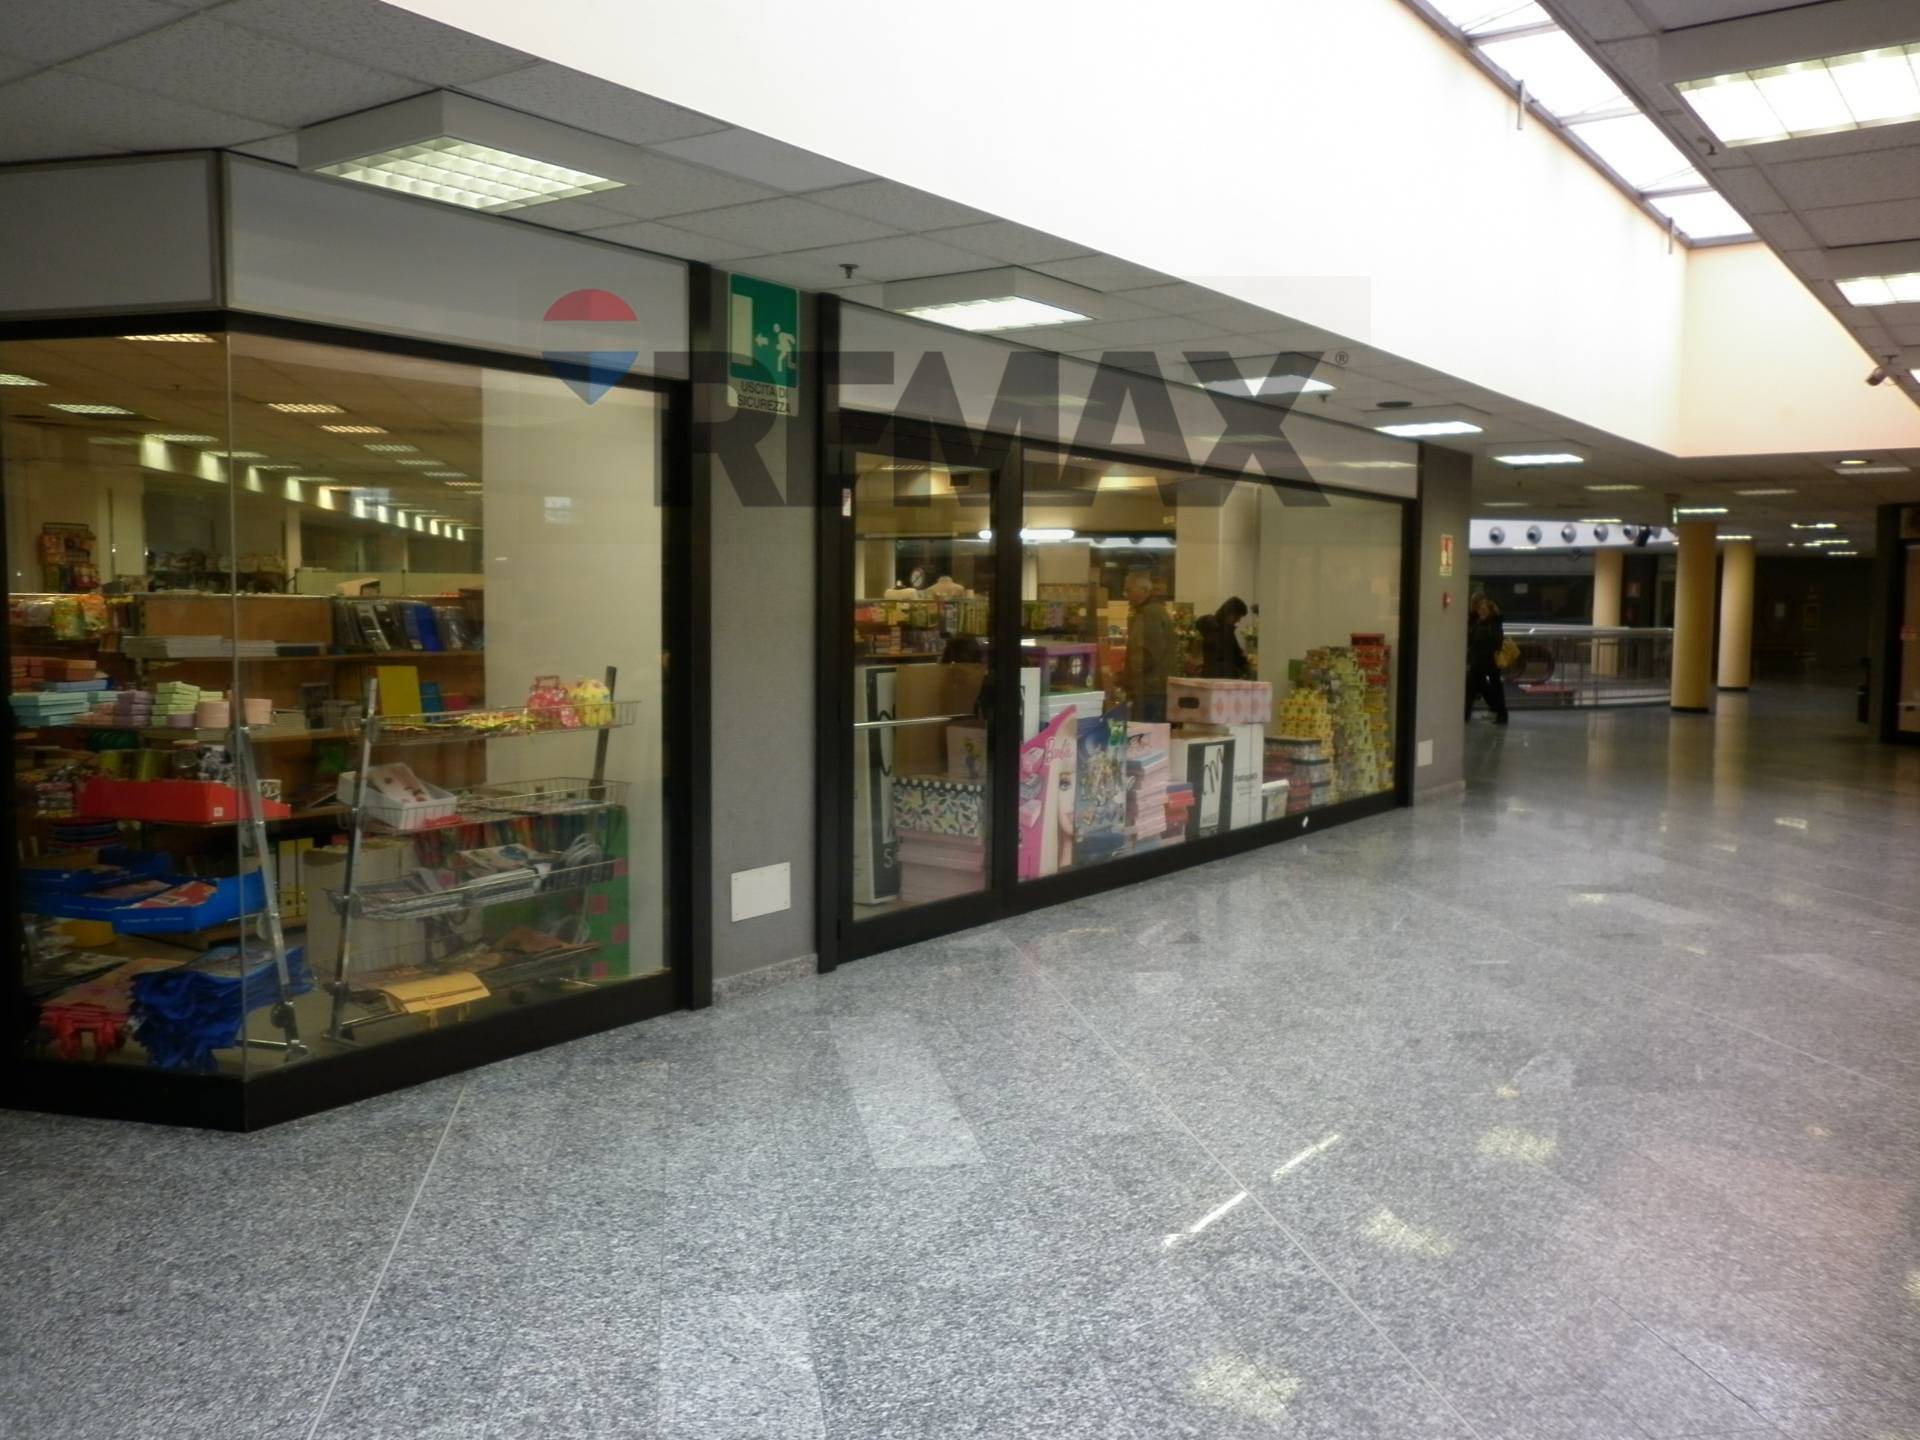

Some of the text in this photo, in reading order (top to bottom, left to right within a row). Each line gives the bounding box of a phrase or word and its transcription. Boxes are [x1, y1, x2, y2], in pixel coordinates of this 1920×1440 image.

[740, 381, 789, 398] USCITA DI
[737, 394, 792, 413] SICUREZZA
